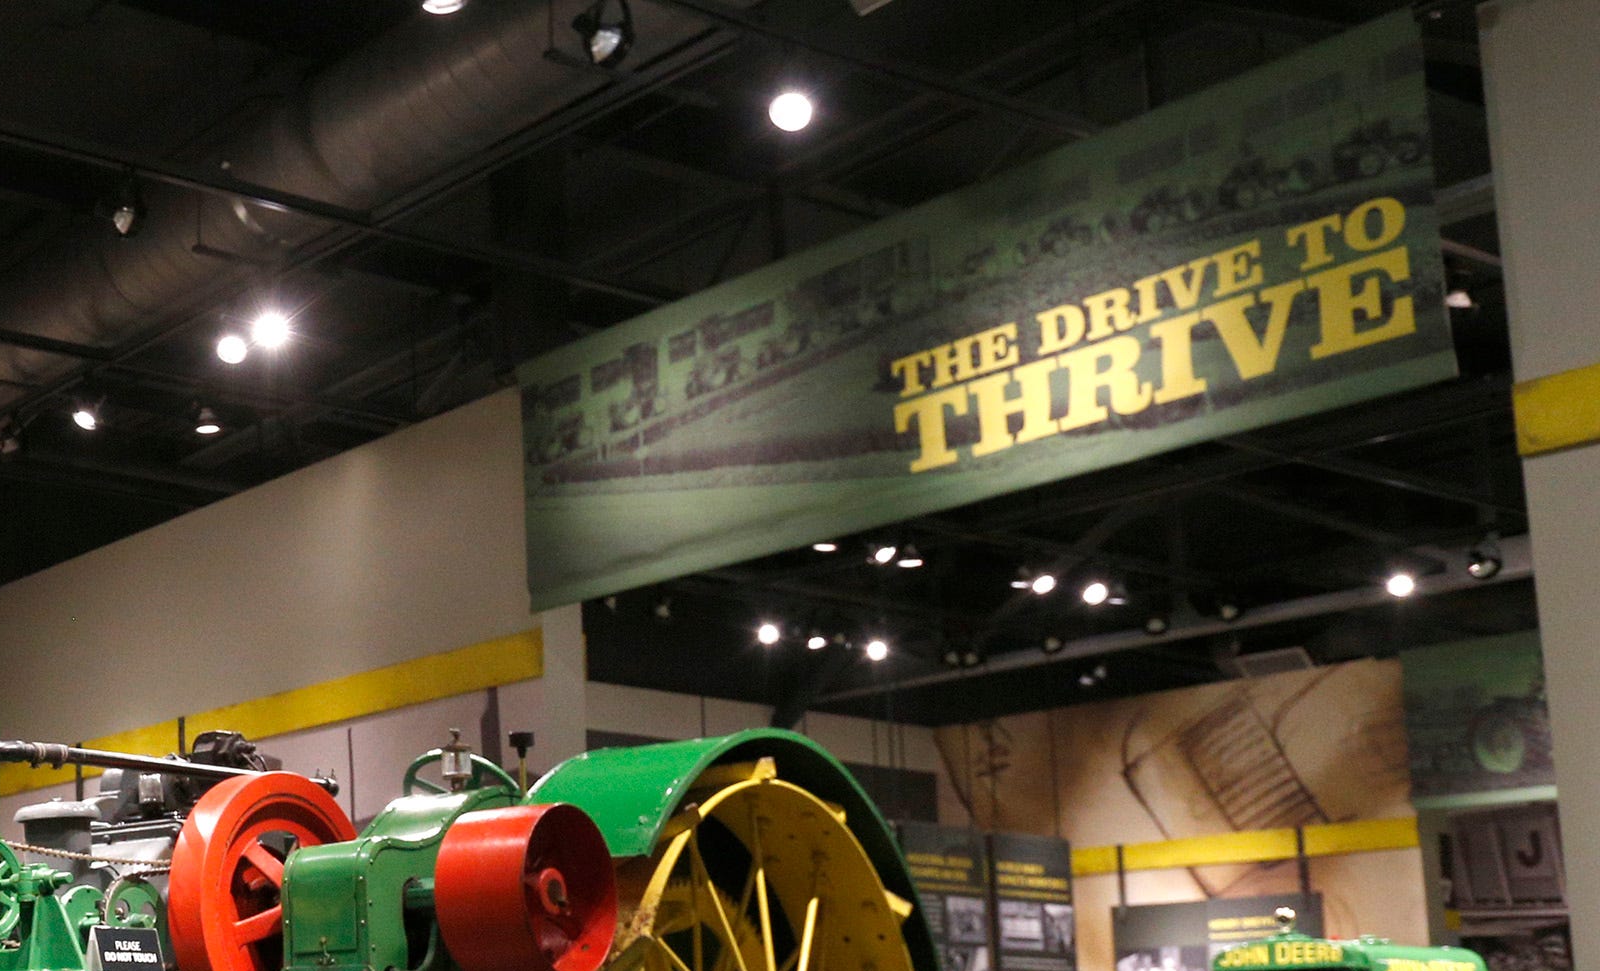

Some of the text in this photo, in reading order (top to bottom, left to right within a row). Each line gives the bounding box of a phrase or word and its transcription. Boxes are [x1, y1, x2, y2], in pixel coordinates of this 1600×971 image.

[890, 197, 1406, 398] THE DRIVE TO
[894, 245, 1417, 472] THRIVE
[103, 951, 158, 963] DO NOT TOUCH
[114, 940, 142, 951] PLEASE
[1219, 941, 1344, 968] JOHN DEERE
